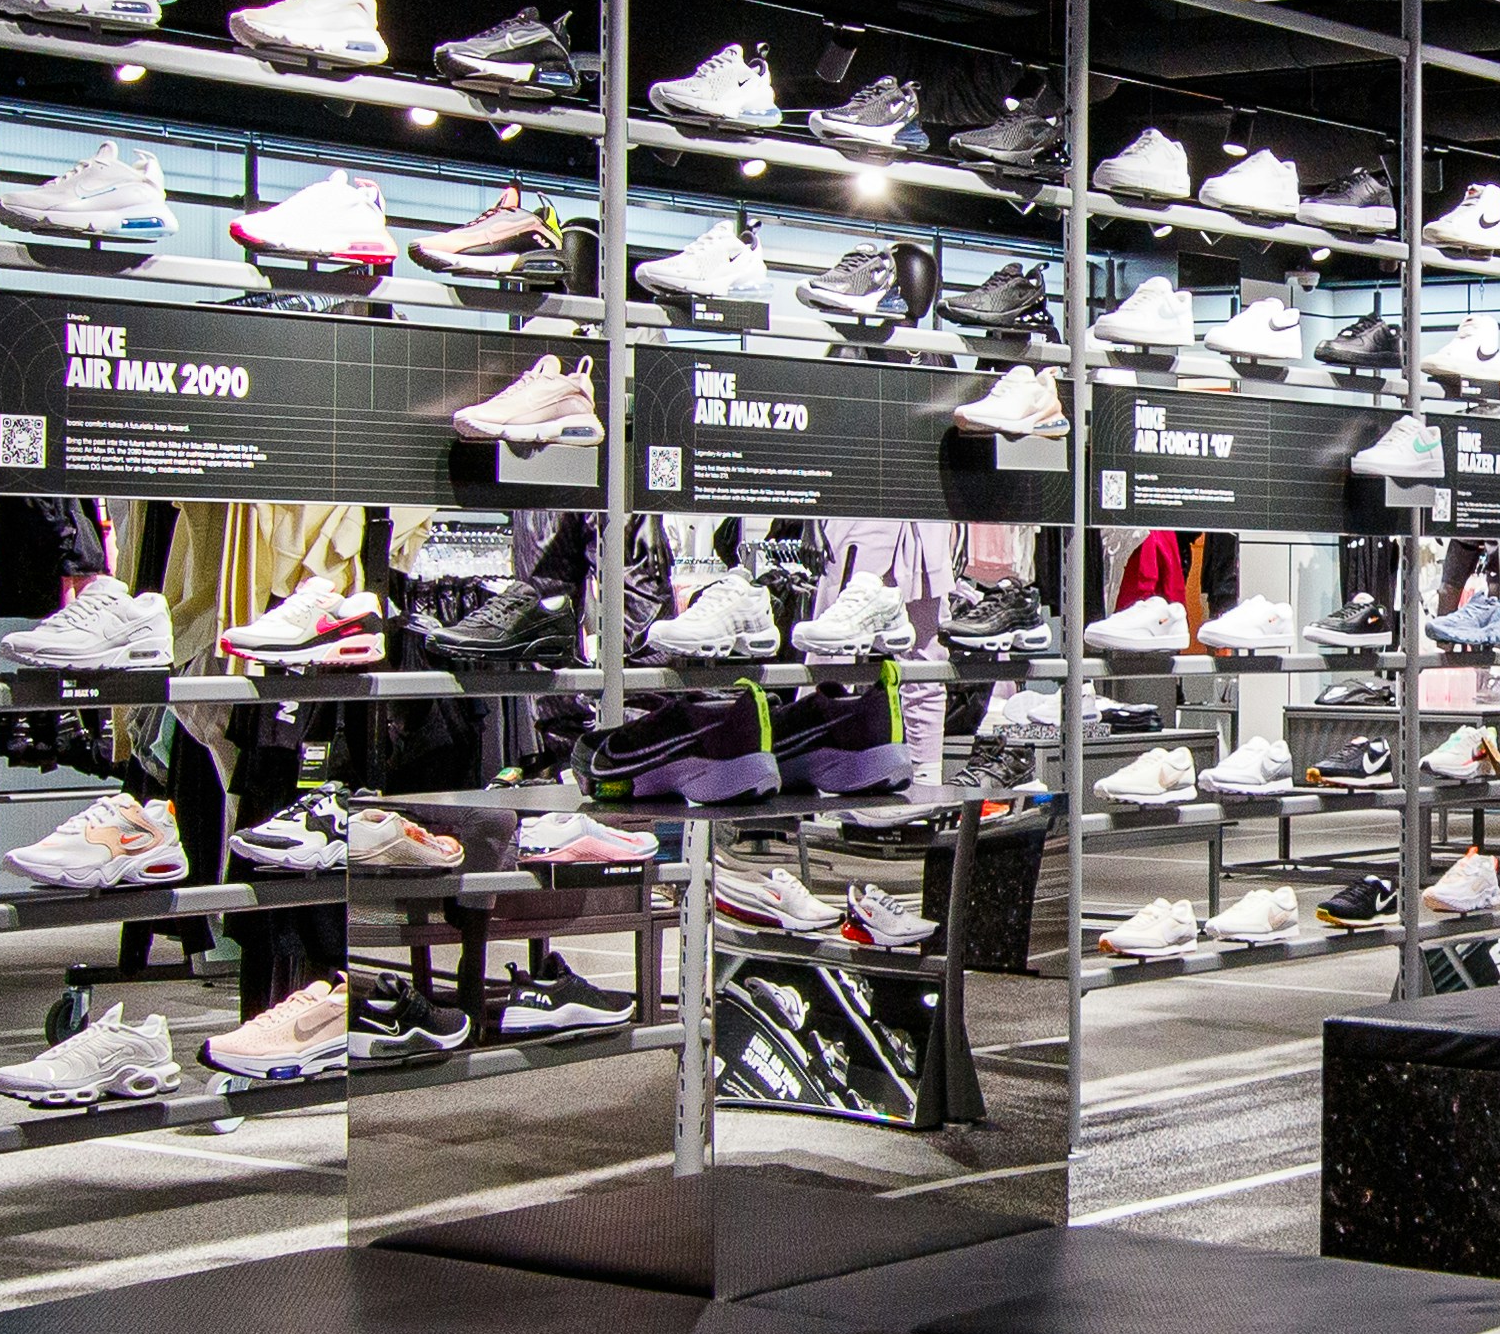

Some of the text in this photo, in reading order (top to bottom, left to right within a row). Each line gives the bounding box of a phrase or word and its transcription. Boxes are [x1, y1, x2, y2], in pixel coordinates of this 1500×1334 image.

[66, 323, 126, 357] NIKE
[66, 357, 249, 398] AIR MAX 2090
[695, 371, 736, 399] NIKE
[694, 398, 808, 431] AIR MAX 270
[1135, 406, 1166, 430] NIKE
[1135, 430, 1158, 453] AIR
[1160, 431, 1199, 456] FORCE
[1201, 433, 1208, 456] 1
[1457, 432, 1481, 452] NIKE
